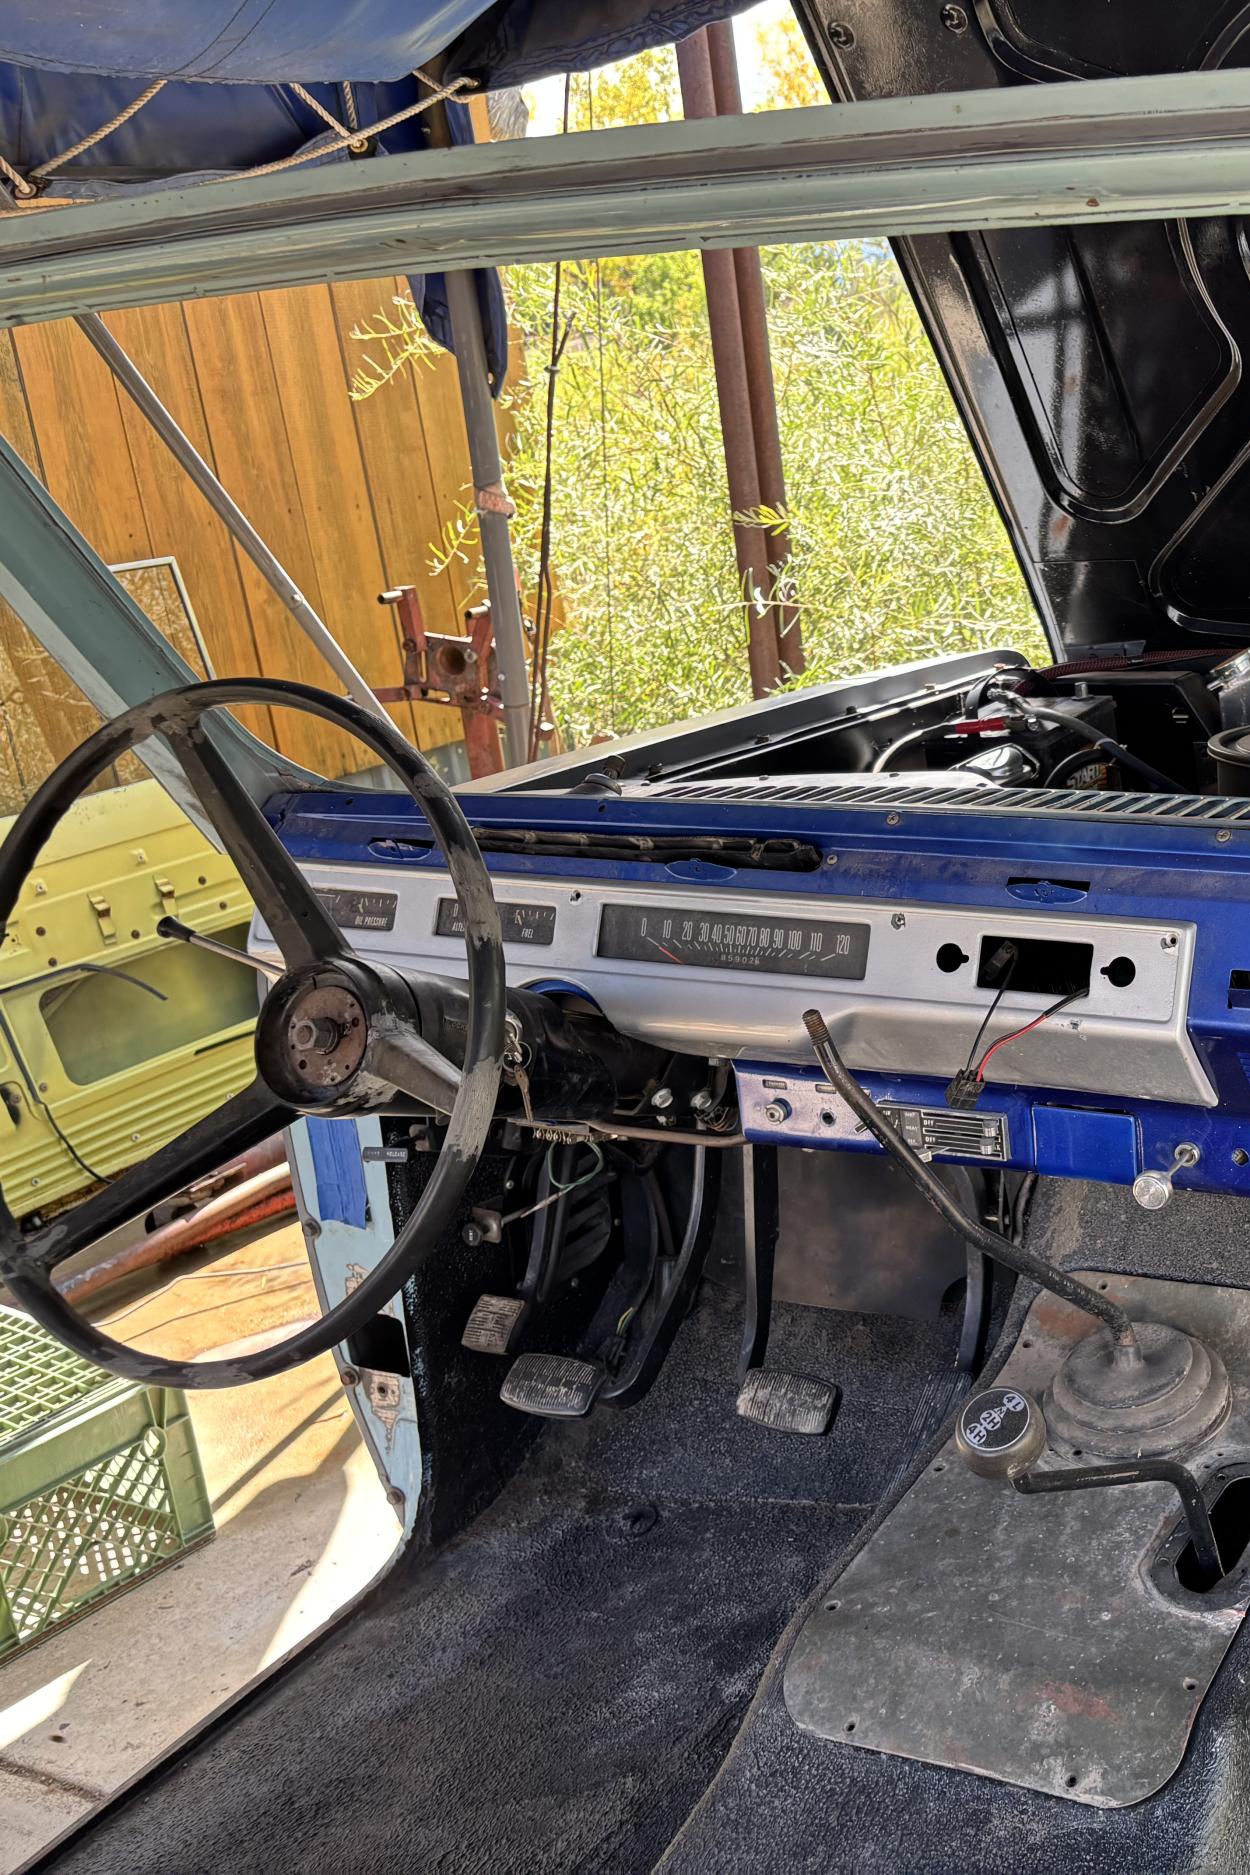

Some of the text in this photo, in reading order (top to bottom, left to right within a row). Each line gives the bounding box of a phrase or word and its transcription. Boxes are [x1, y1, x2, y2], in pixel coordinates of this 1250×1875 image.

[354, 915, 387, 927] OIL PRESSURE
[522, 928, 534, 939] FUEL
[640, 918, 850, 954] 0 10 20 30 40 50 60 70 80 90 100 110 120
[1005, 1395, 1022, 1410] 4L
[982, 1412, 1000, 1429] 2H
[968, 1425, 985, 1443] 4H
